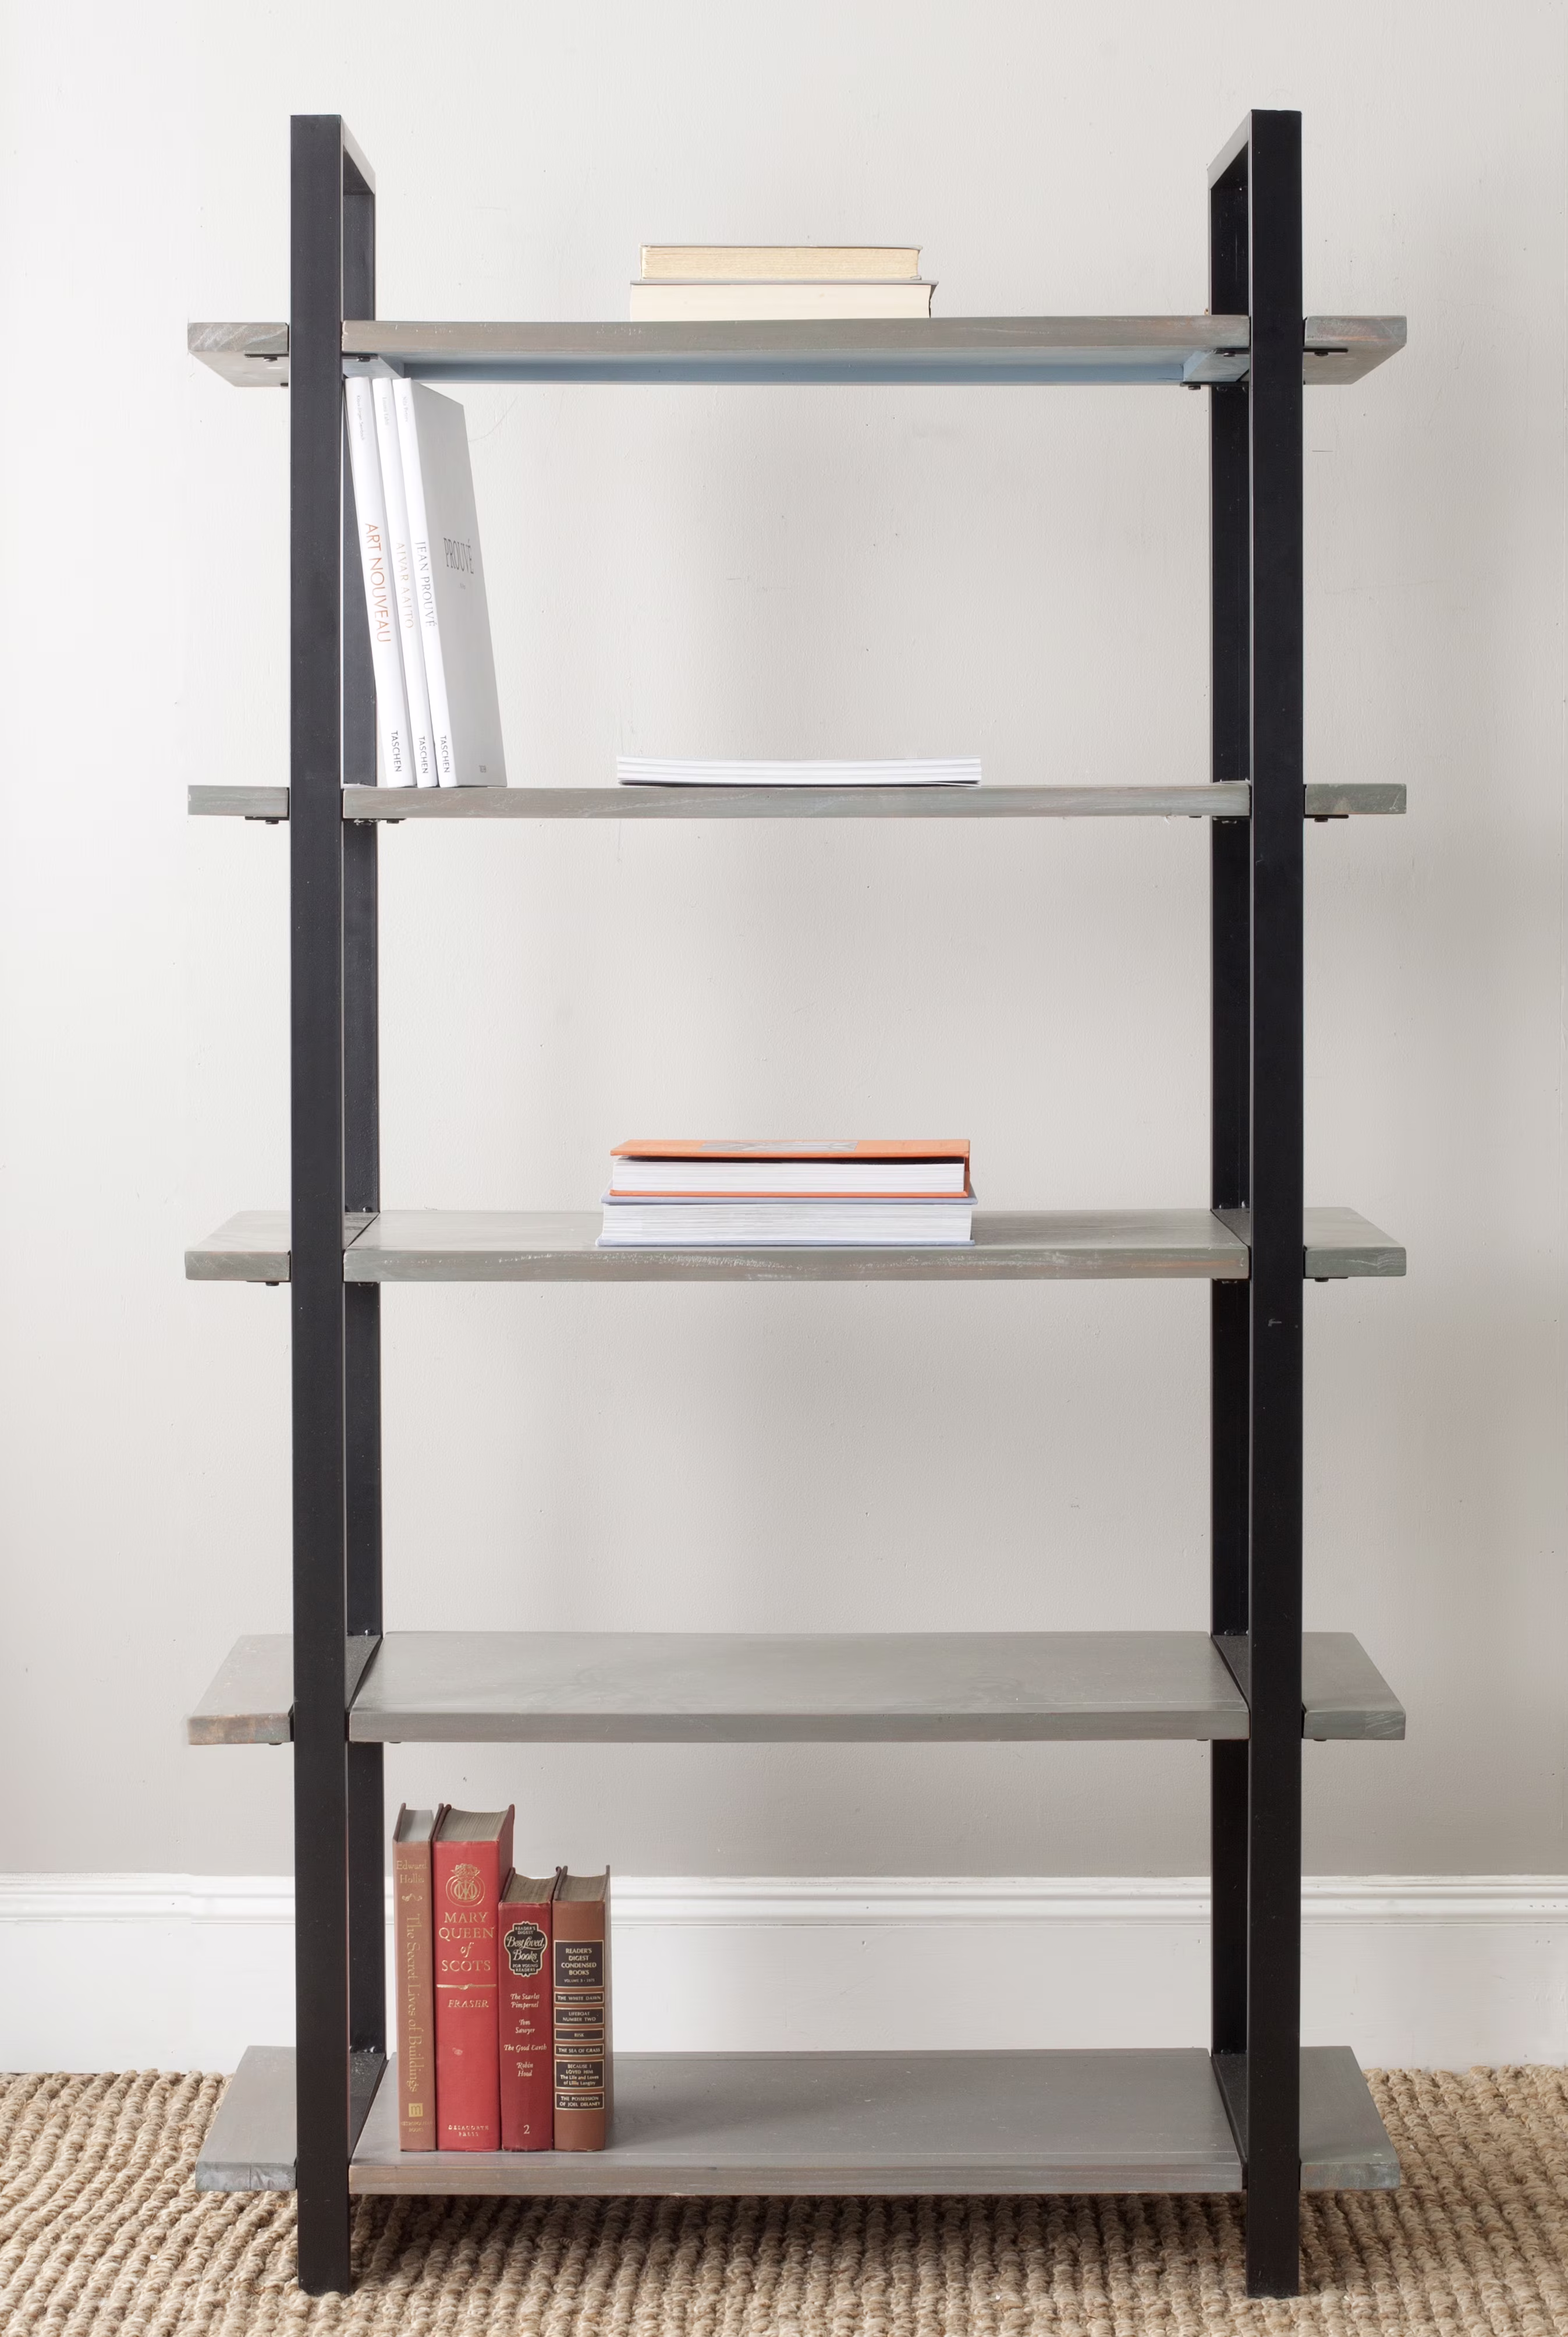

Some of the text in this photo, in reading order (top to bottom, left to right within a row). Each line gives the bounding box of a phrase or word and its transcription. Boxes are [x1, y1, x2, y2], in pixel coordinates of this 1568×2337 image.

[444, 537, 474, 574] PROUVÉ
[365, 523, 391, 642] ART NOUVEAU
[414, 541, 437, 627] JEAN PROUVÉ
[391, 731, 402, 772] TASCHEN
[418, 736, 428, 774] TASCHEN
[440, 735, 450, 773] TASCHEN
[396, 1860, 428, 1869] Edward
[400, 1873, 424, 1883] Hollis
[444, 1912, 488, 1924] MARY
[439, 1927, 494, 1942] QUEEN
[460, 1942, 474, 1958] of
[506, 1936, 545, 1950] Best Loved
[513, 1949, 538, 1963] Books
[441, 1960, 491, 1972] SCOTS
[406, 1914, 424, 2092] The Secret Lives of Buildings
[448, 1999, 489, 2008] FRASER
[510, 2001, 539, 2010] Pimpernel
[516, 2045, 530, 2053] Good
[523, 2124, 530, 2134] 2
